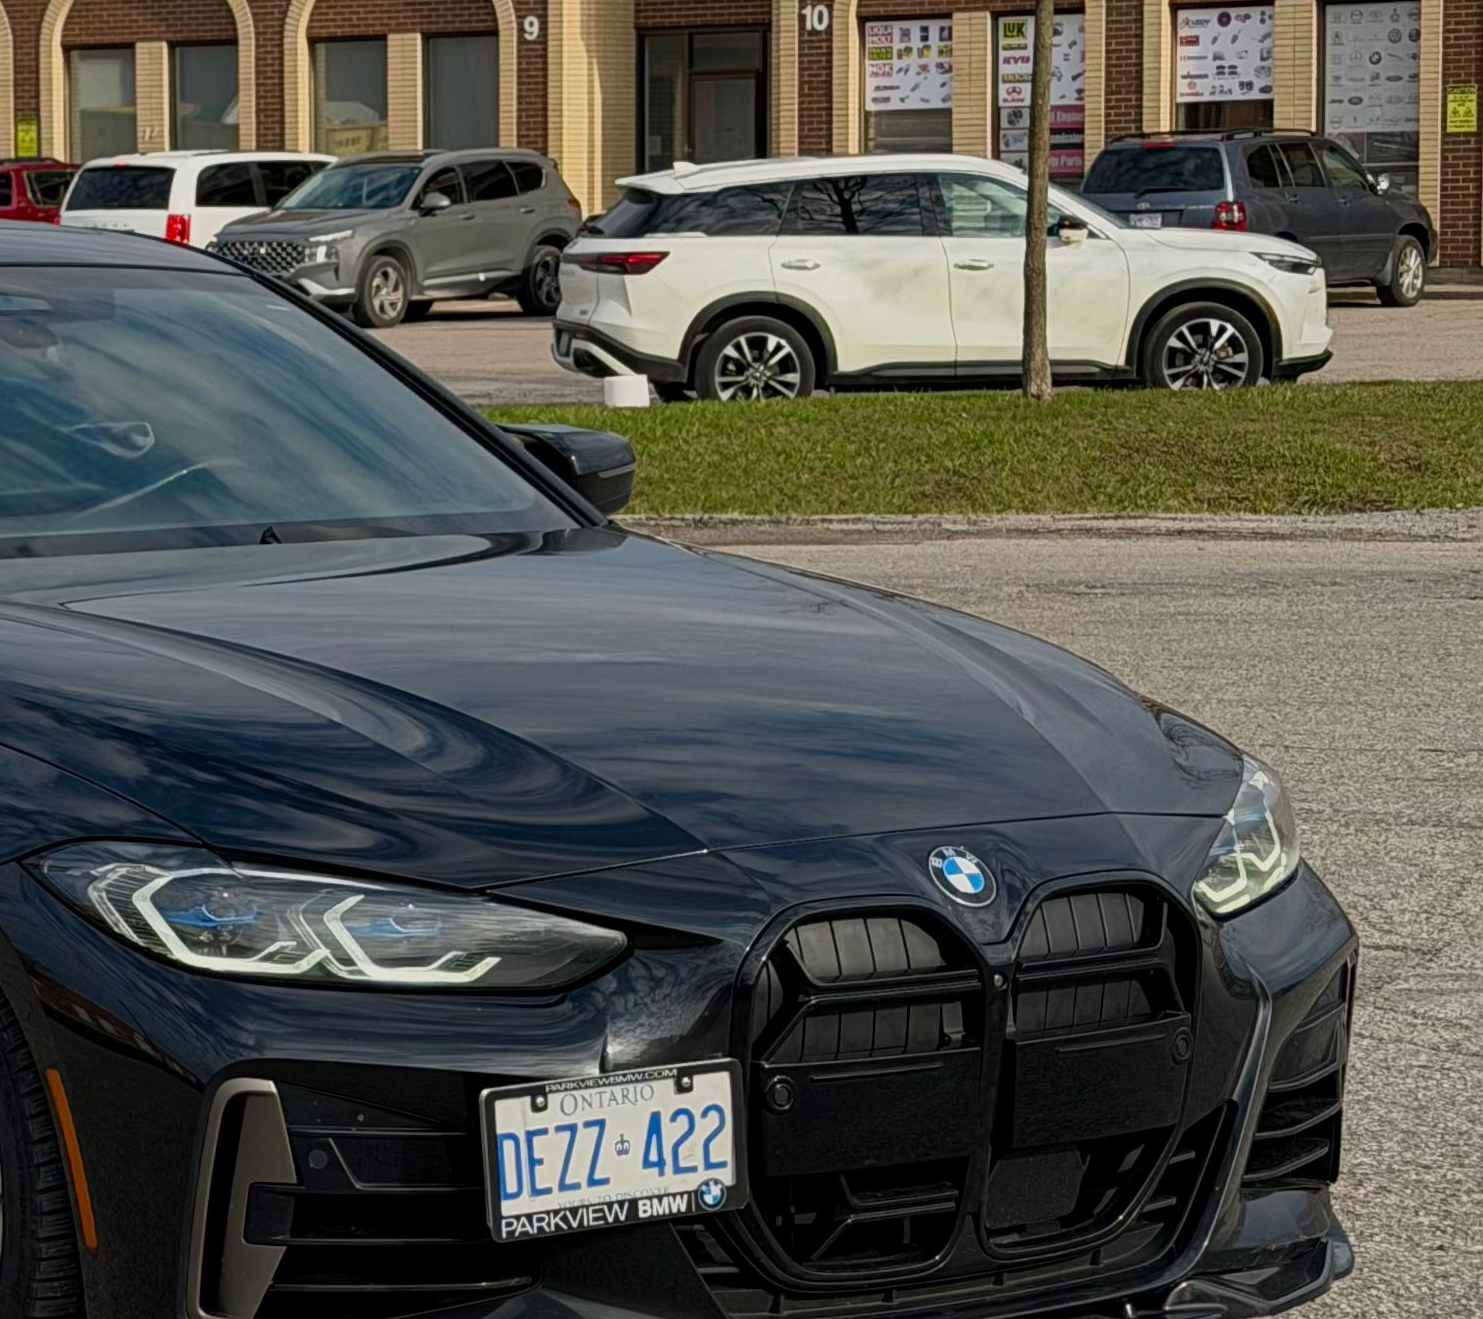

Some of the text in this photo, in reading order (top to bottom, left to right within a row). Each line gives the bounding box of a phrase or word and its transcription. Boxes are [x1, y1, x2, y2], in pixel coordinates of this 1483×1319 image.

[523, 15, 539, 41] 9
[801, 4, 829, 31] 10
[545, 1068, 678, 1094] PARKVIEWBMW.COM
[559, 1083, 655, 1116] ONTARIO
[497, 1103, 729, 1201] DEZZ 422
[501, 1200, 630, 1240] PARKVIEW
[637, 1193, 689, 1219] BMW
